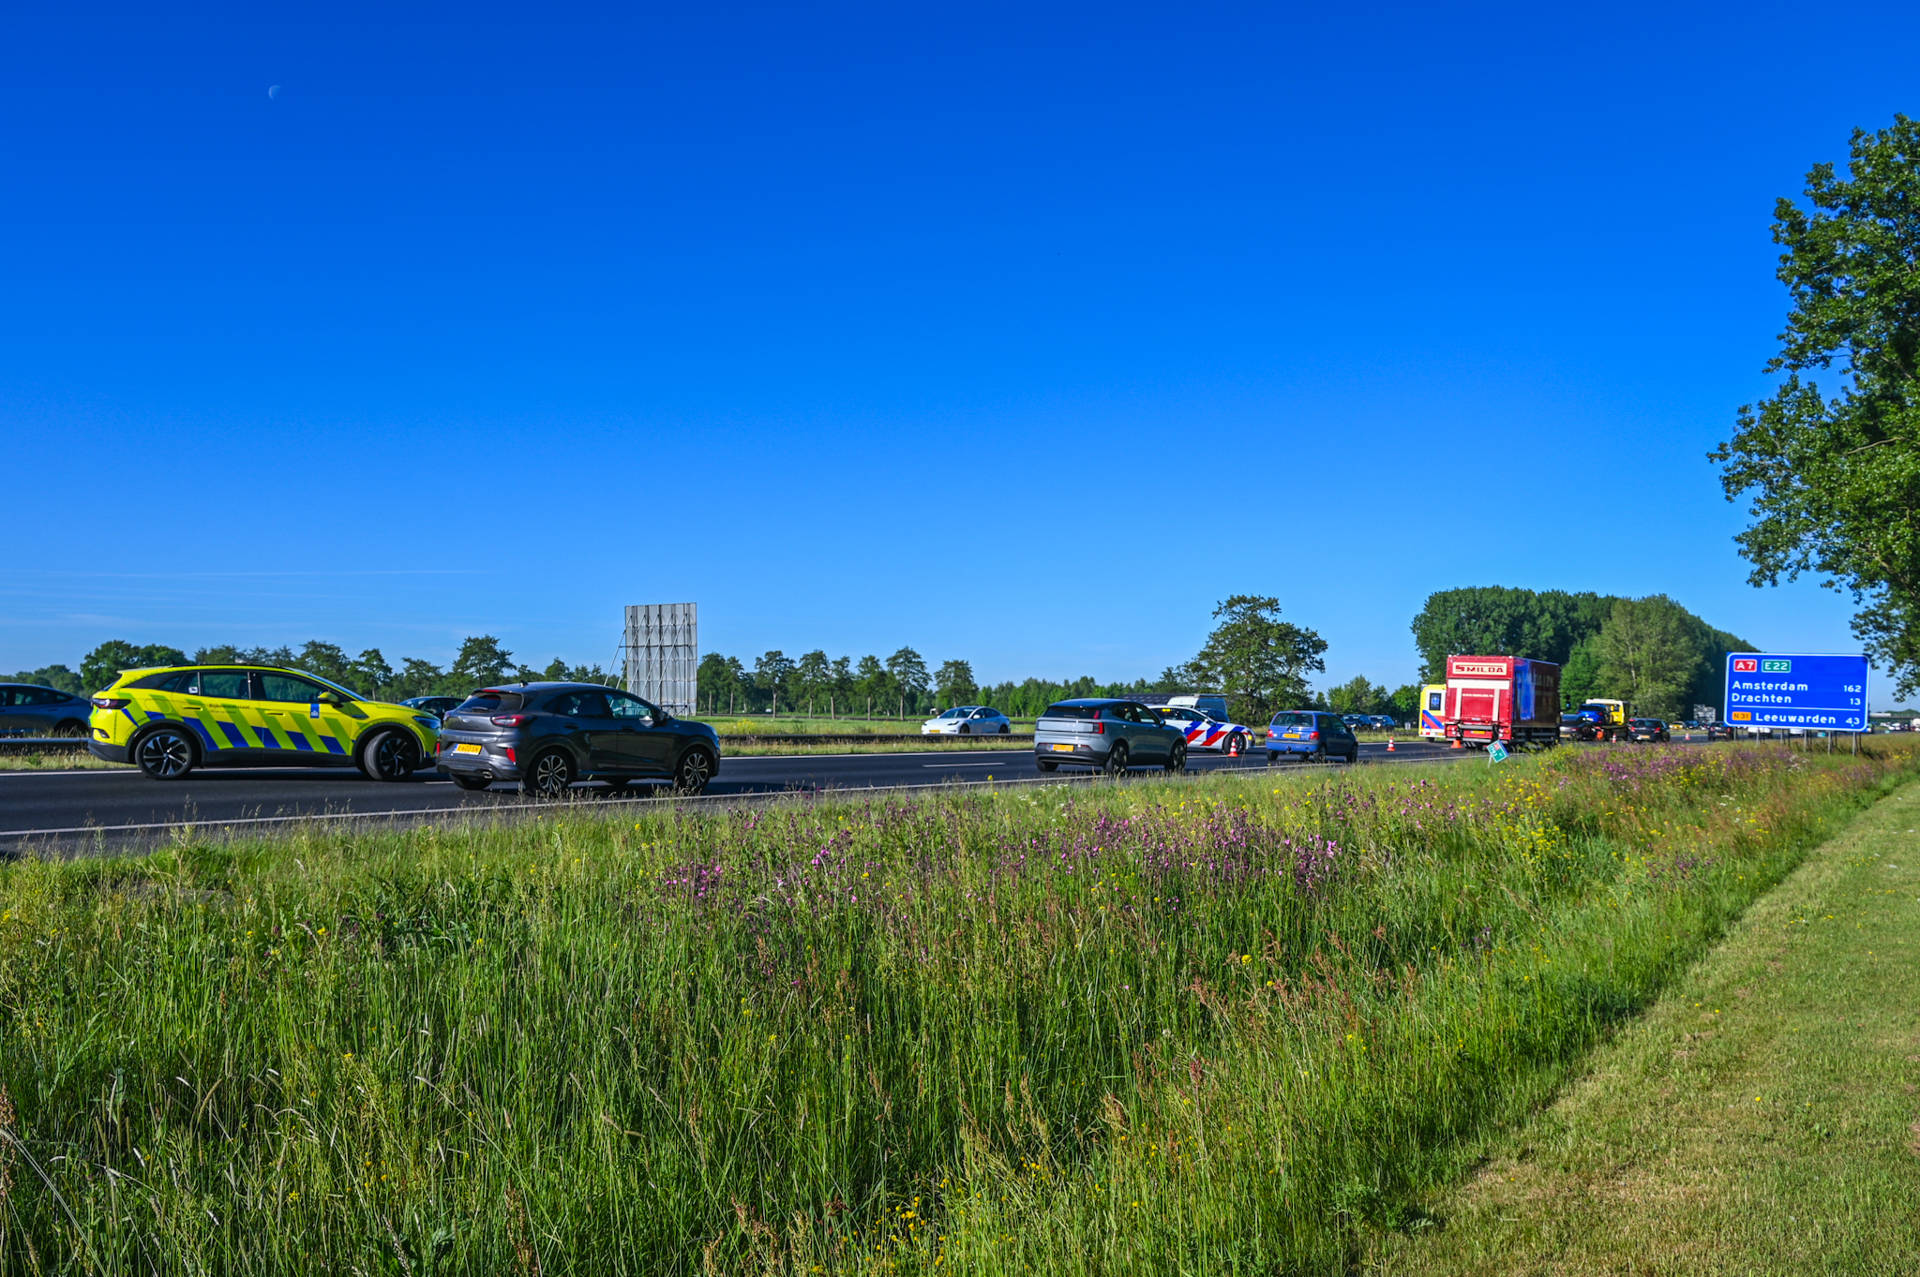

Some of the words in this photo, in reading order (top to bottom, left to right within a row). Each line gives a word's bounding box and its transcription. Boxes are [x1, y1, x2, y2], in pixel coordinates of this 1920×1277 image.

[1455, 664, 1504, 673] SMILDA
[1764, 661, 1788, 671] E22
[1732, 681, 1808, 691] Amsterdam
[1844, 685, 1862, 693] 162
[1731, 693, 1792, 703] Drachten
[1850, 698, 1861, 706] 13
[1755, 713, 1836, 724] Leeuwarden
[1845, 717, 1860, 725] 43
